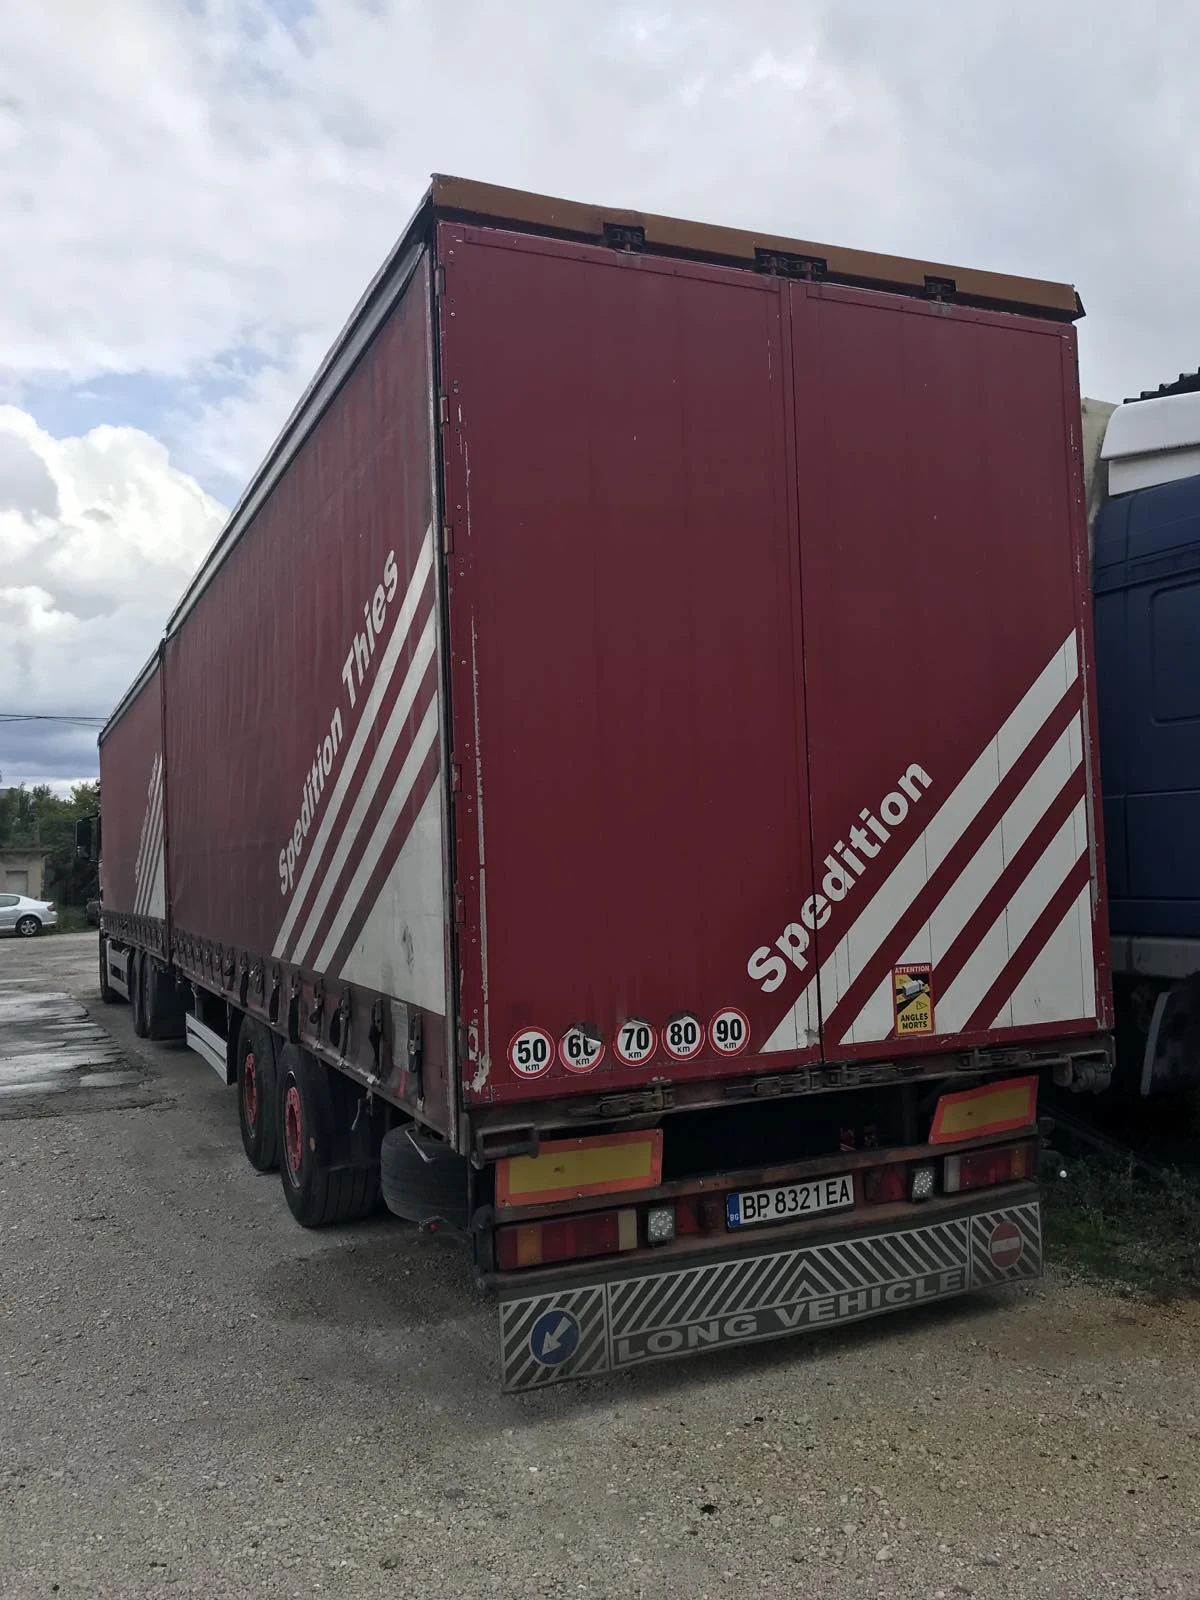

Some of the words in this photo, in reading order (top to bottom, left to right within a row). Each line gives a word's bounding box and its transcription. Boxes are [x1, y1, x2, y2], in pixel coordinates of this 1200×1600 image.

[277, 706, 343, 896] Spedition
[341, 549, 399, 709] Thies
[746, 762, 934, 993] Spedition
[894, 965, 930, 974] ATTENTION
[900, 1013, 929, 1022] ANGLES
[901, 1021, 928, 1030] MORTS
[622, 1027, 650, 1051] 70
[670, 1022, 697, 1046] 80
[716, 1018, 743, 1042] 90
[517, 1038, 547, 1064] 50
[774, 1184, 821, 1214] 8321
[825, 1179, 851, 1206] EA
[729, 1213, 740, 1222] BG
[617, 1314, 758, 1360] LONG
[775, 1268, 963, 1328] VEHICLE
